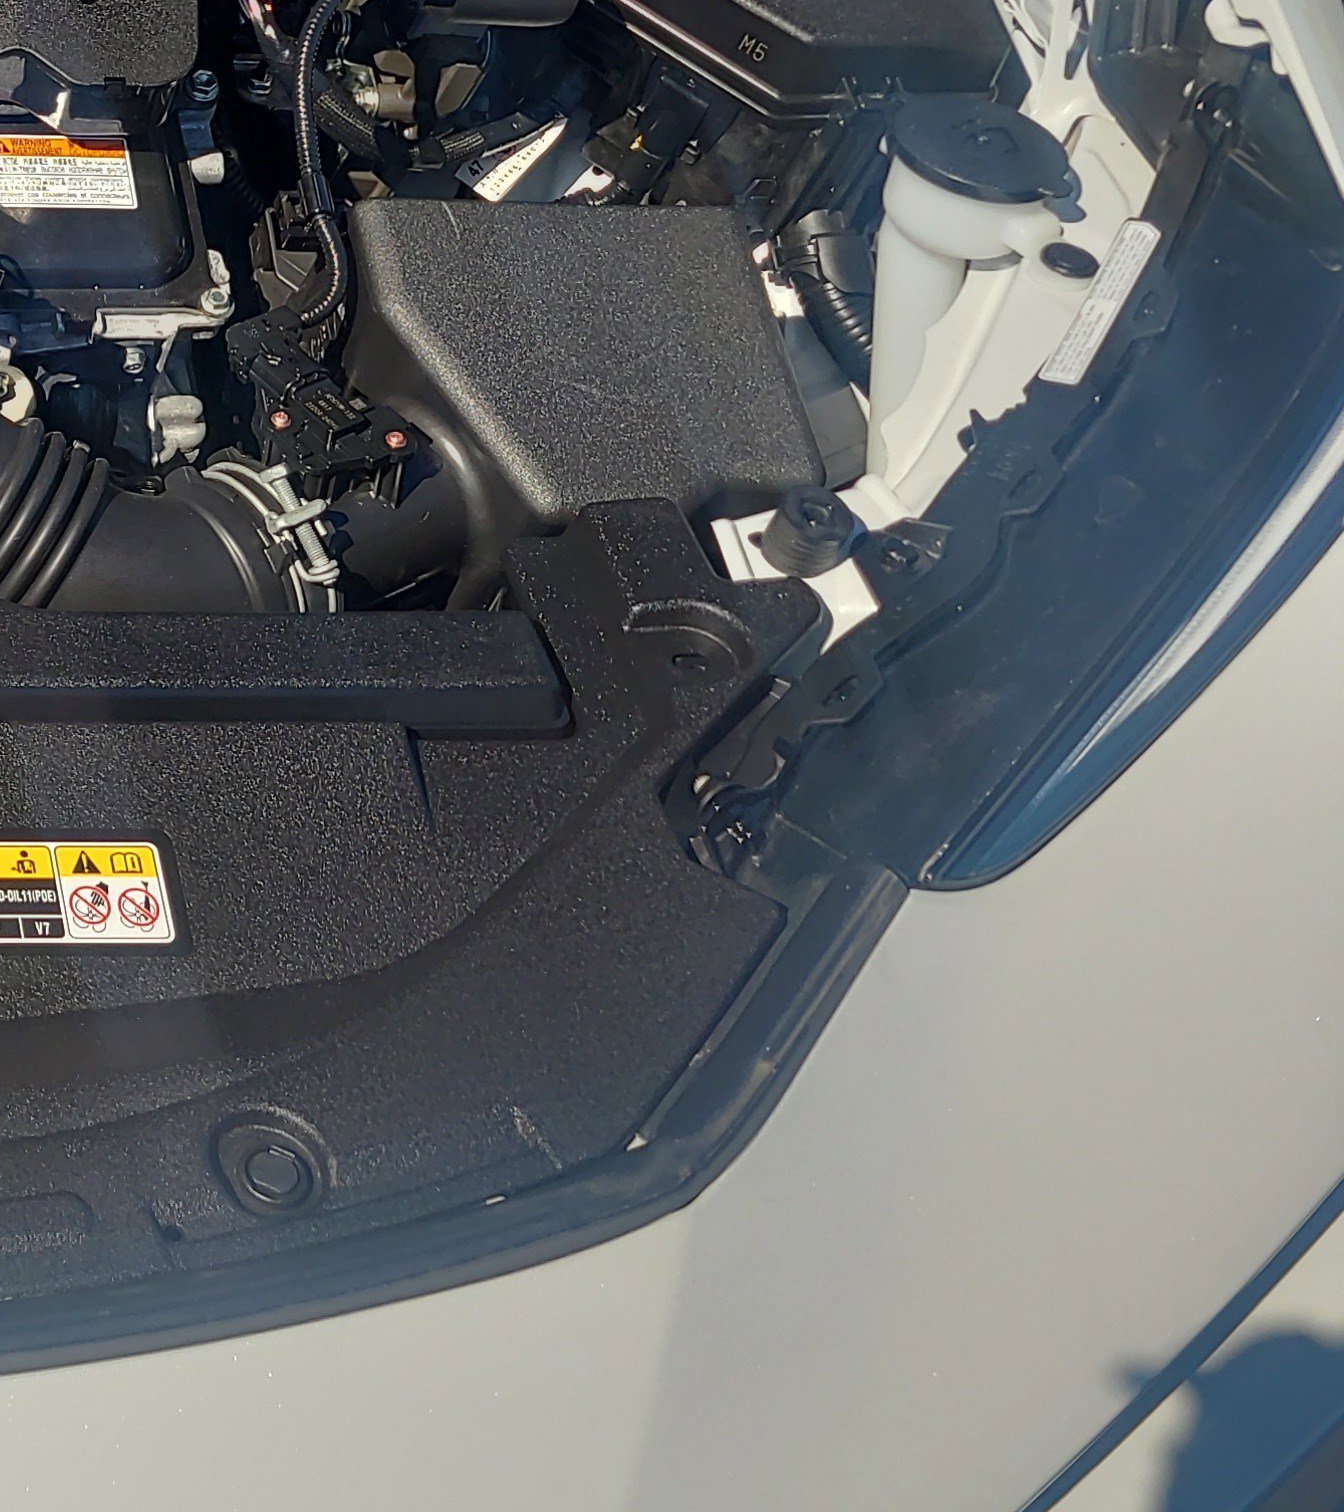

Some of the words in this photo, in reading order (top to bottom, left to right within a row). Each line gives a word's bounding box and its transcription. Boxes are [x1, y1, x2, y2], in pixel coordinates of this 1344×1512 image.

[737, 33, 769, 62] M5
[12, 139, 52, 148] WARNING
[467, 159, 484, 178] 47
[34, 920, 51, 936] V7
